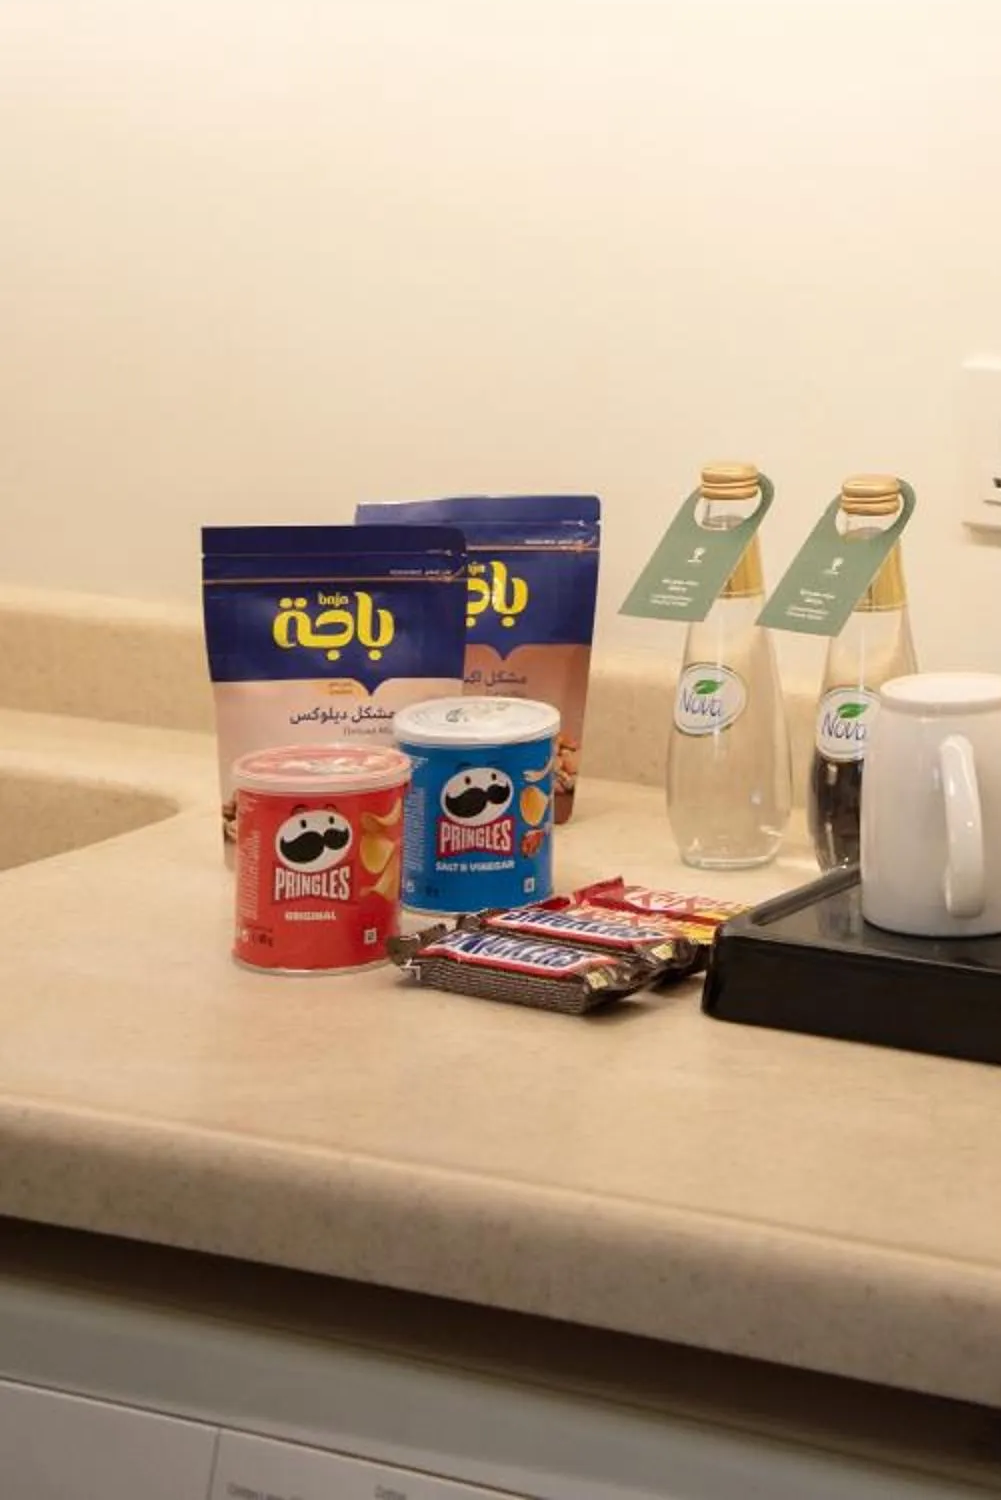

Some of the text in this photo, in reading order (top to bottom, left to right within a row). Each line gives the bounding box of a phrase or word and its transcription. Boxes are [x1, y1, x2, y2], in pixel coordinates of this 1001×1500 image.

[272, 591, 395, 662] باجة
[679, 688, 724, 719] Nova
[821, 711, 869, 741] Nova
[439, 819, 512, 853] PRINGLES
[436, 861, 459, 872] SALT
[470, 860, 516, 873] VINEGAR
[273, 866, 352, 901] PRINGLES
[284, 909, 337, 921] ORIGINAL
